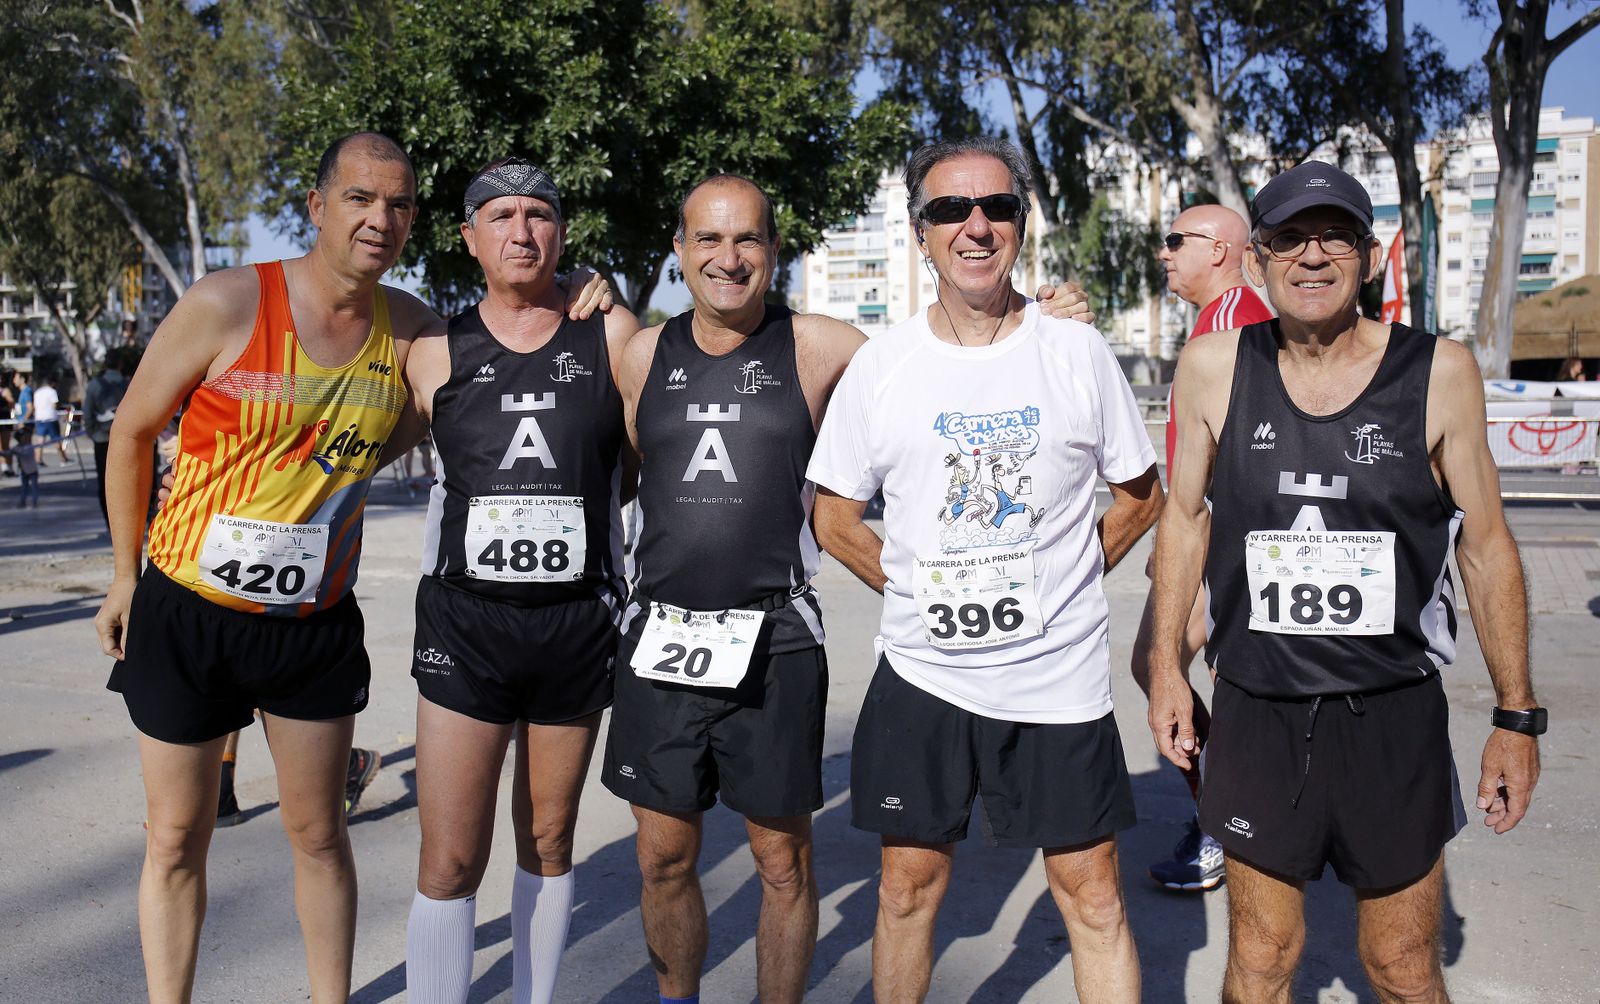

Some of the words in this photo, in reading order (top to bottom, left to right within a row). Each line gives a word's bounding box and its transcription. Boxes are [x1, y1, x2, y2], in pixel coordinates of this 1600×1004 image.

[666, 383, 687, 391] mobel
[947, 412, 1024, 434] Carrera
[1250, 442, 1275, 450] mobel
[1373, 440, 1394, 448] PLAYAS
[548, 499, 574, 507] PRENS
[511, 508, 533, 518] APM
[227, 520, 264, 531] CARRERA
[279, 526, 290, 534] LA
[254, 533, 275, 544] APM
[1261, 534, 1306, 543] CARRERA
[1309, 535, 1323, 543] DE
[1325, 535, 1339, 543] LA
[1341, 535, 1383, 544] PRENSA
[478, 539, 569, 573] 488
[1296, 545, 1322, 557] APM
[919, 560, 927, 568] IV
[927, 560, 962, 568] CARRERA
[965, 559, 977, 567] DE
[979, 557, 990, 565] LA
[992, 552, 1025, 563] PRENSA
[211, 559, 306, 596] 420
[955, 568, 977, 580] APM
[1260, 582, 1363, 625] 189
[725, 612, 755, 623] PRENSA
[927, 597, 1024, 639] 396
[652, 642, 713, 678] 20
[1224, 822, 1253, 838] Kalenji
